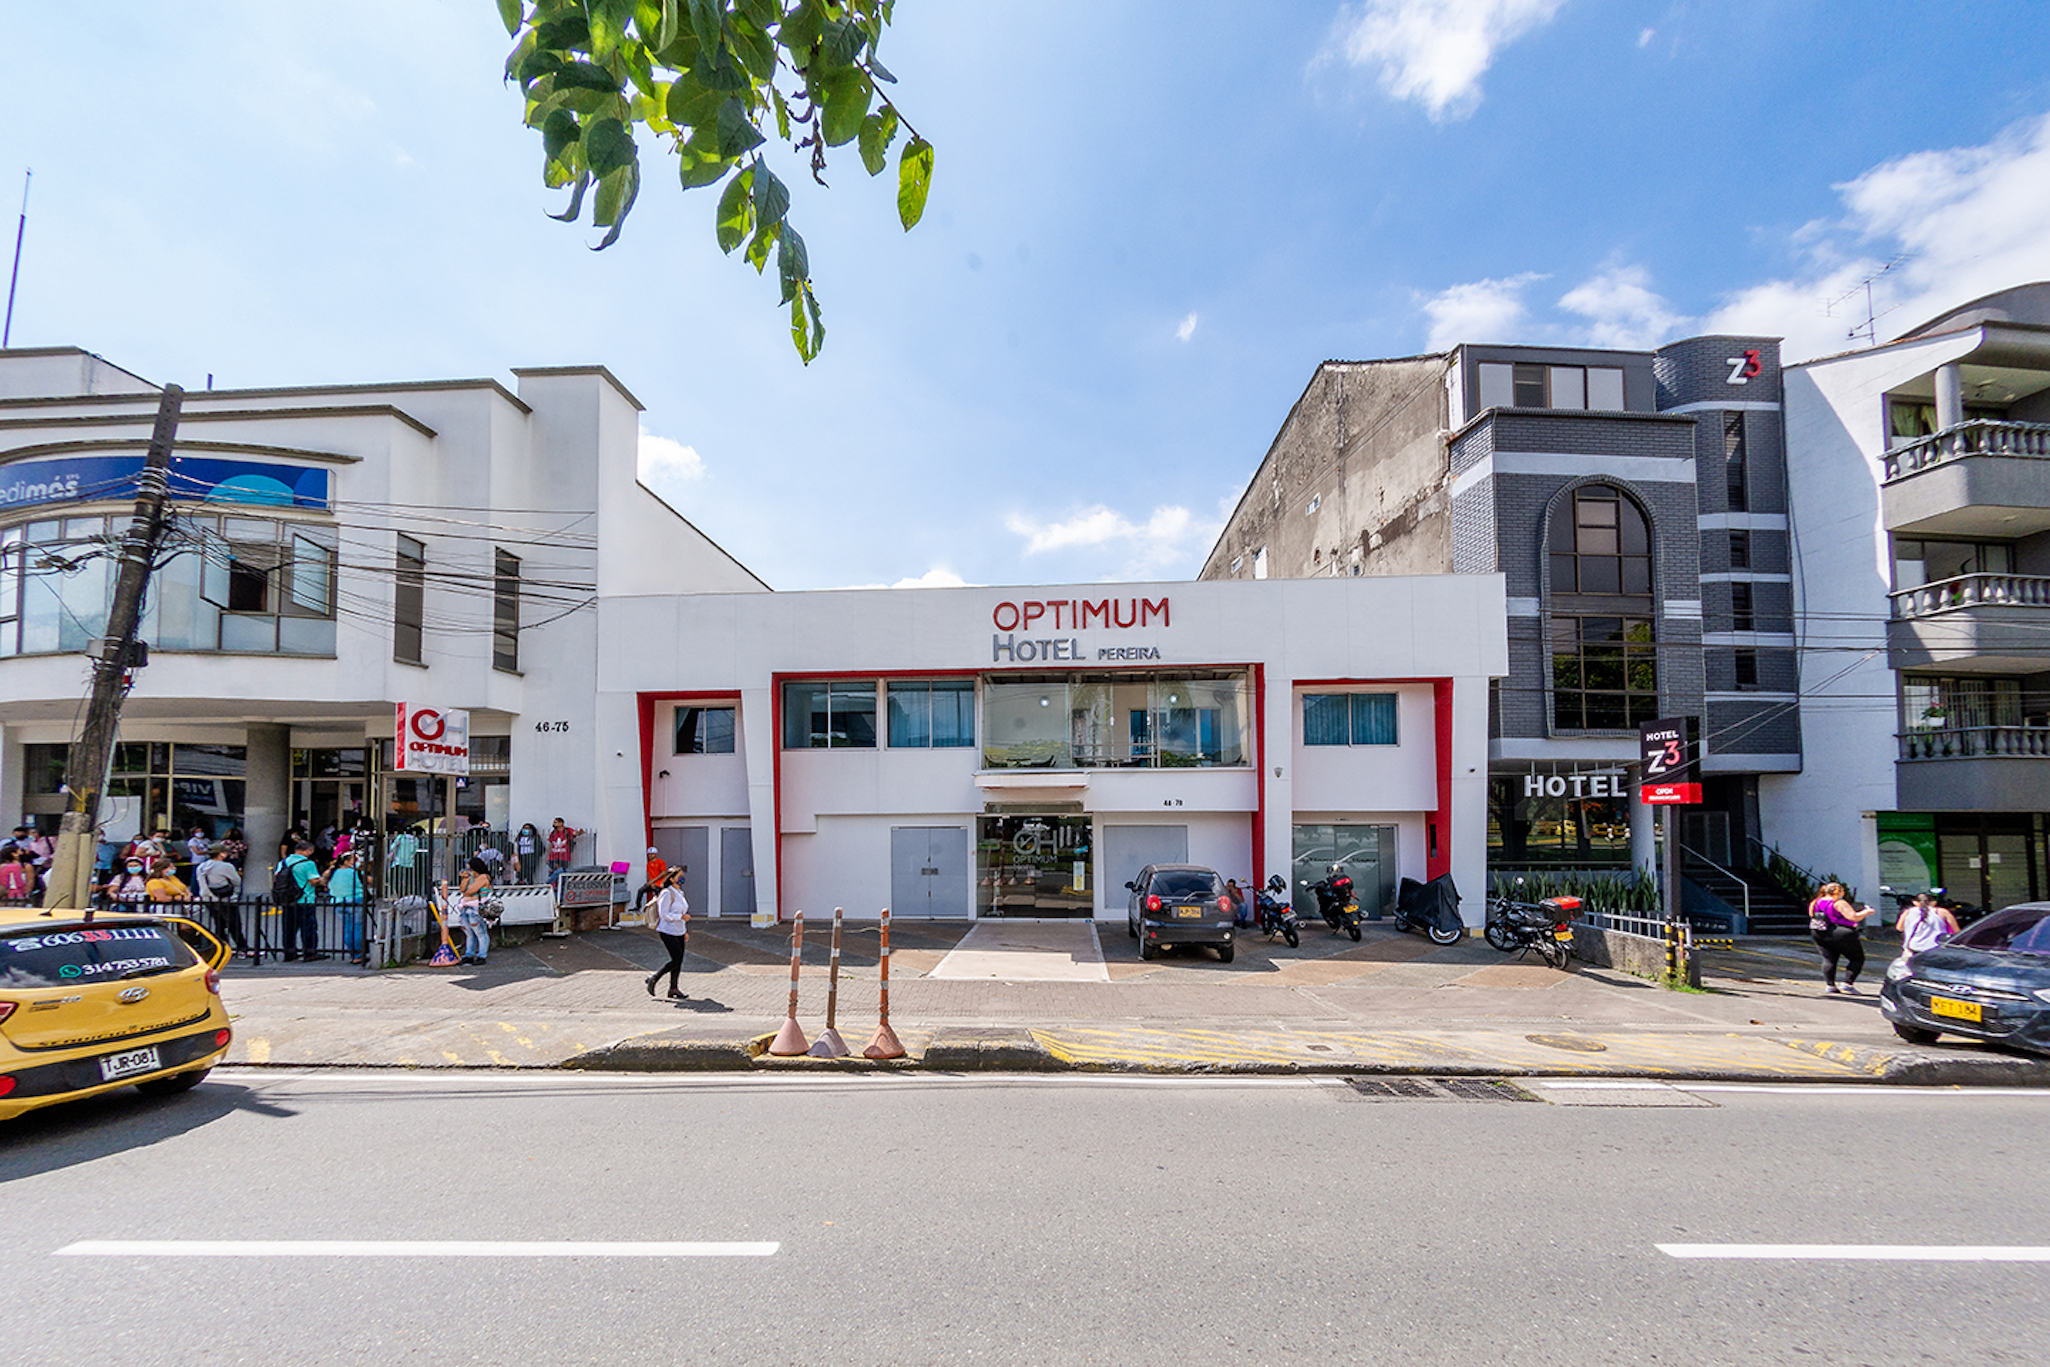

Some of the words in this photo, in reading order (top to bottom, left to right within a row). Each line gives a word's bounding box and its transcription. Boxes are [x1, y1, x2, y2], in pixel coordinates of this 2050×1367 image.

[1726, 349, 1762, 385] Z3
[993, 597, 1170, 631] OPTIMUM
[993, 634, 1086, 662] HOTEL
[1098, 646, 1161, 660] PEREIRA
[535, 721, 569, 732] 46-75
[1646, 730, 1679, 742] HOTEL
[409, 741, 467, 757] OPTIMUM
[1648, 740, 1681, 773] Z3
[408, 752, 467, 773] HOTEL
[1524, 775, 1628, 797] HOTEL
[1013, 855, 1058, 863] OPTIMUM
